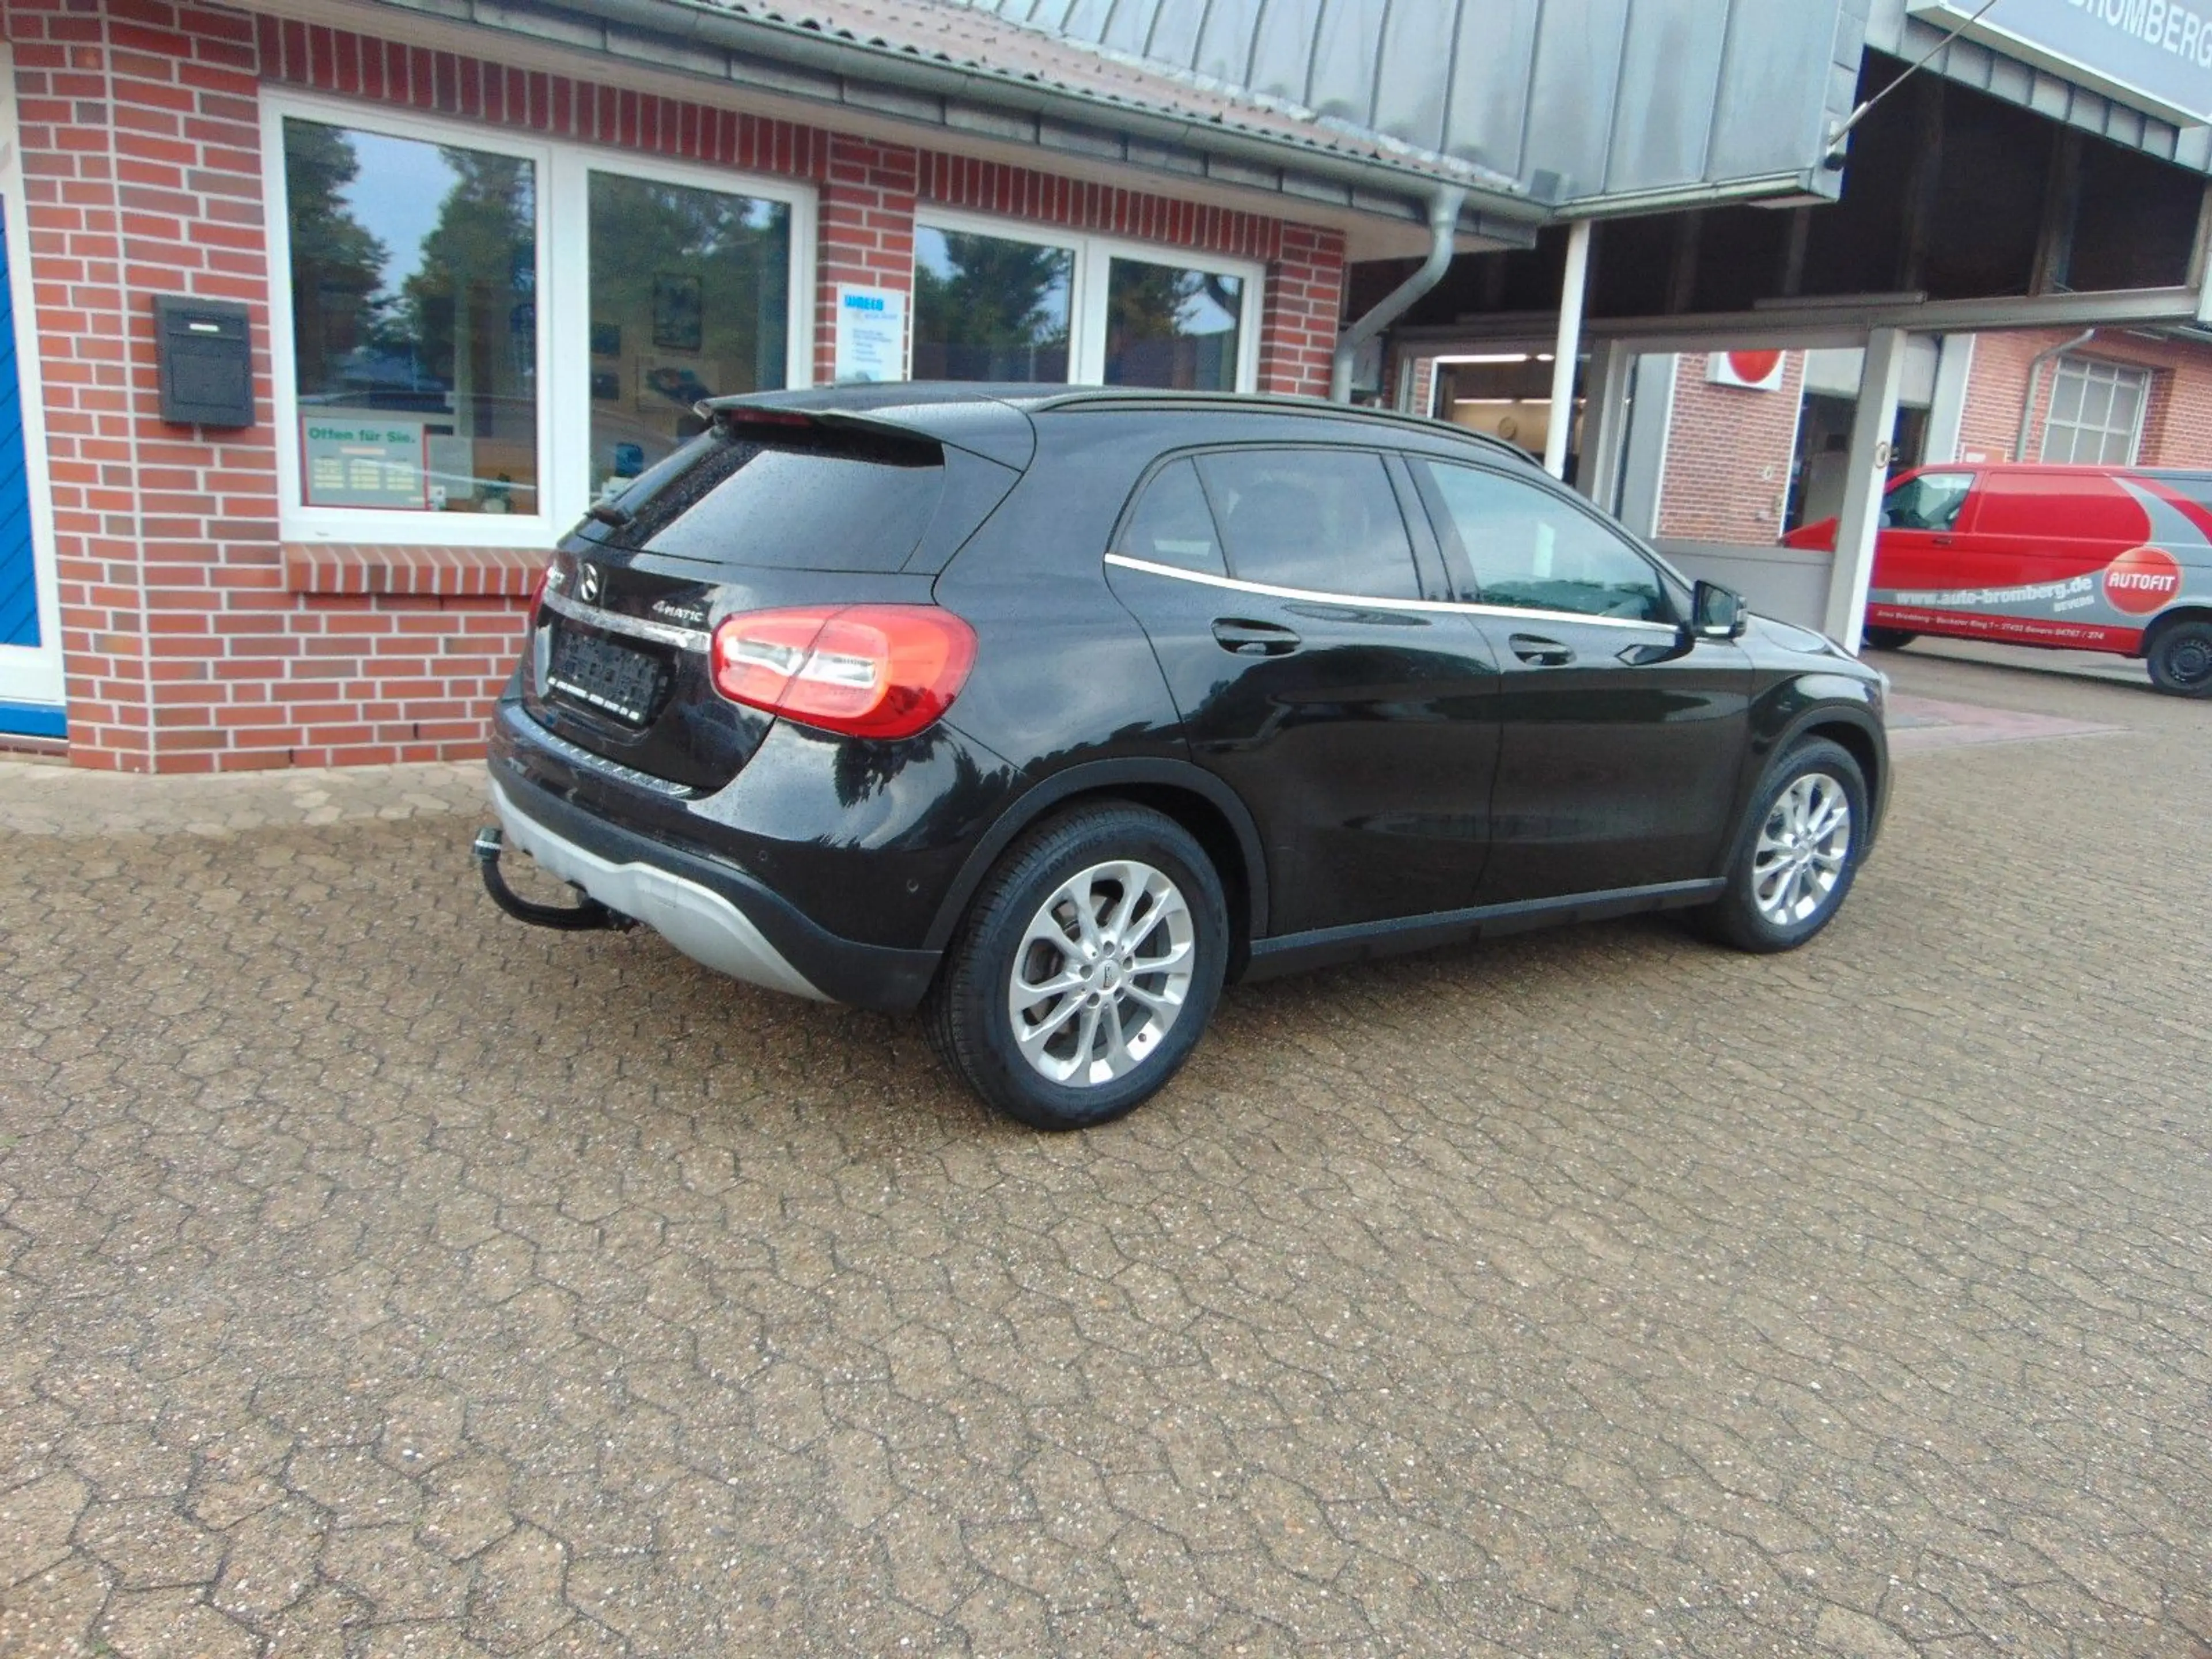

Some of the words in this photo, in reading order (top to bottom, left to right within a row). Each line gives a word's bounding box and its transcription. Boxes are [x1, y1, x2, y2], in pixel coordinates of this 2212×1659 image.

[2069, 0, 2212, 68] OMBERG
[308, 427, 354, 440] Offen
[359, 429, 381, 442] für
[2108, 571, 2176, 591] AUTOFIT
[652, 600, 706, 622] 4MATIC
